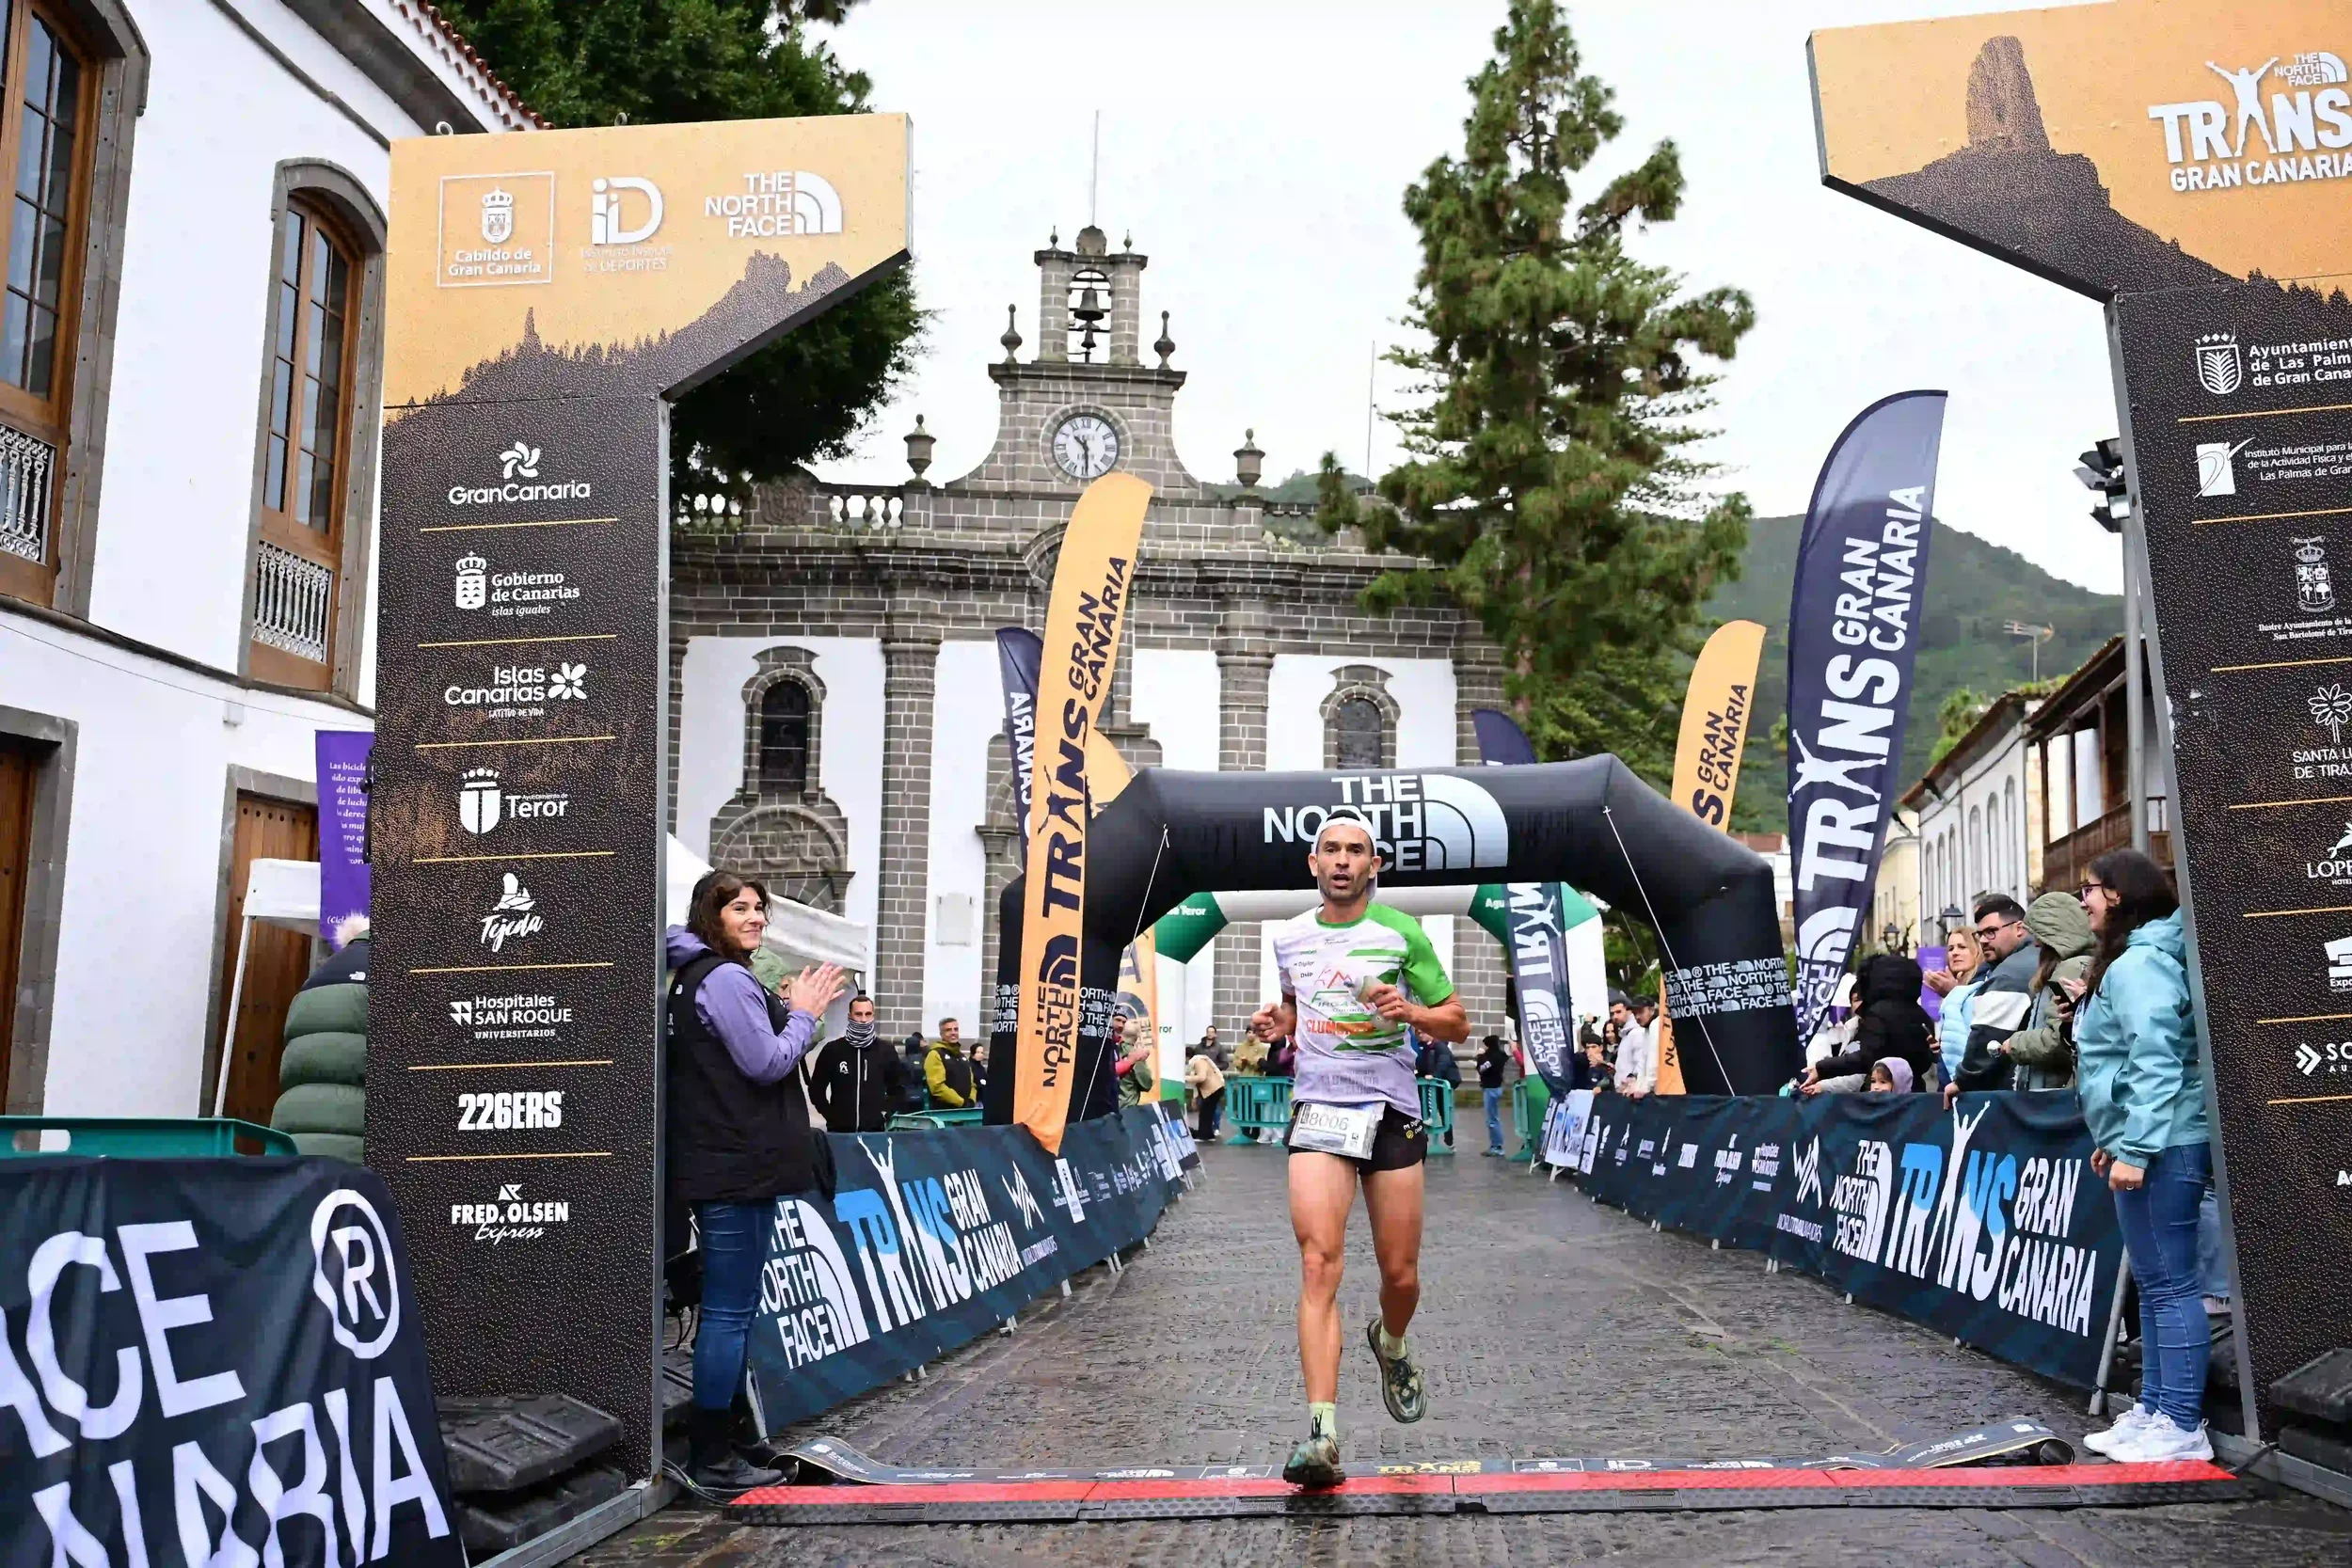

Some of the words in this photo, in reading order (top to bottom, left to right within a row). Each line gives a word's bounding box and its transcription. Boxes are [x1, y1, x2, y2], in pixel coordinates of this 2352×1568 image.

[2294, 53, 2319, 64] THE
[2274, 62, 2321, 77] NORTH
[2287, 74, 2322, 87] FACE
[743, 172, 792, 193] THE
[2170, 162, 2242, 192] GRAN
[705, 194, 792, 217] NORTH
[727, 215, 792, 238] FACE
[455, 249, 512, 263] Cabildo
[515, 248, 532, 261] de
[448, 262, 484, 277] Gran
[486, 260, 541, 275] Canaria
[2251, 361, 2270, 372] de
[2279, 357, 2304, 370] Las
[2253, 375, 2271, 387] de
[2275, 371, 2310, 385] Gran
[2245, 450, 2280, 458] Instituto
[2281, 444, 2324, 455] Municipal
[2326, 443, 2345, 453] para
[2270, 456, 2311, 467] Actividad
[2338, 454, 2344, 463] y
[2260, 471, 2276, 481] Las
[2279, 468, 2312, 479] Palmas
[2314, 467, 2328, 476] de
[448, 480, 591, 505] GranCanaria
[491, 571, 564, 587] Gobierno
[1868, 485, 1925, 652] CANARIA
[491, 588, 510, 601] de
[512, 585, 580, 600] Canarias
[1832, 537, 1880, 646] GRAN
[491, 605, 513, 616] islas
[515, 604, 551, 617] iguales
[1084, 557, 1127, 702] CANARIA
[1068, 591, 1099, 691] GRAN
[494, 666, 546, 685] Islas
[445, 683, 546, 705] Canarias
[1697, 711, 1724, 784] GRAN
[1713, 684, 1748, 792] CANARIA
[2292, 748, 2339, 763] SANTA
[1795, 655, 1900, 892] TRANS
[2294, 767, 2313, 780] DE
[1331, 774, 1421, 803] THE
[338, 797, 346, 805] de
[505, 795, 568, 818] Teror
[1263, 802, 1422, 843] NOTH
[1182, 904, 1206, 916] Teror
[480, 913, 543, 952] Tejeda
[1703, 962, 1731, 976] THE
[1754, 957, 1785, 971] NORTH
[1728, 972, 1772, 986] NORTH
[475, 994, 555, 1012] Hospitales
[1001, 997, 1019, 1008] THE
[1080, 987, 1108, 1002] ORTH
[1707, 987, 1743, 1002] FACE
[1740, 996, 1774, 1010] FACE
[475, 1010, 511, 1026] SAN
[513, 1007, 572, 1023] ROQUE
[1087, 1013, 1104, 1024] THE
[475, 1028, 556, 1040] UNIVERSITARIOS
[1042, 984, 1063, 1087] NORTH
[1057, 992, 1074, 1064] FACE
[458, 1091, 562, 1131] 226ERS
[1856, 1139, 1882, 1180] THE
[944, 1168, 991, 1230] GRAN
[1831, 1174, 1874, 1213] NORTH
[2013, 1156, 2082, 1240] GRAN
[507, 1201, 569, 1222] OLSEN
[1885, 1140, 2017, 1302] TRANS
[475, 1221, 545, 1248] Express
[1833, 1213, 1867, 1258] FACE
[834, 1174, 972, 1334] TRANS
[963, 1221, 1023, 1293] CANARIA
[1997, 1235, 2098, 1338] CANARIA
[777, 1304, 836, 1370] FACE
